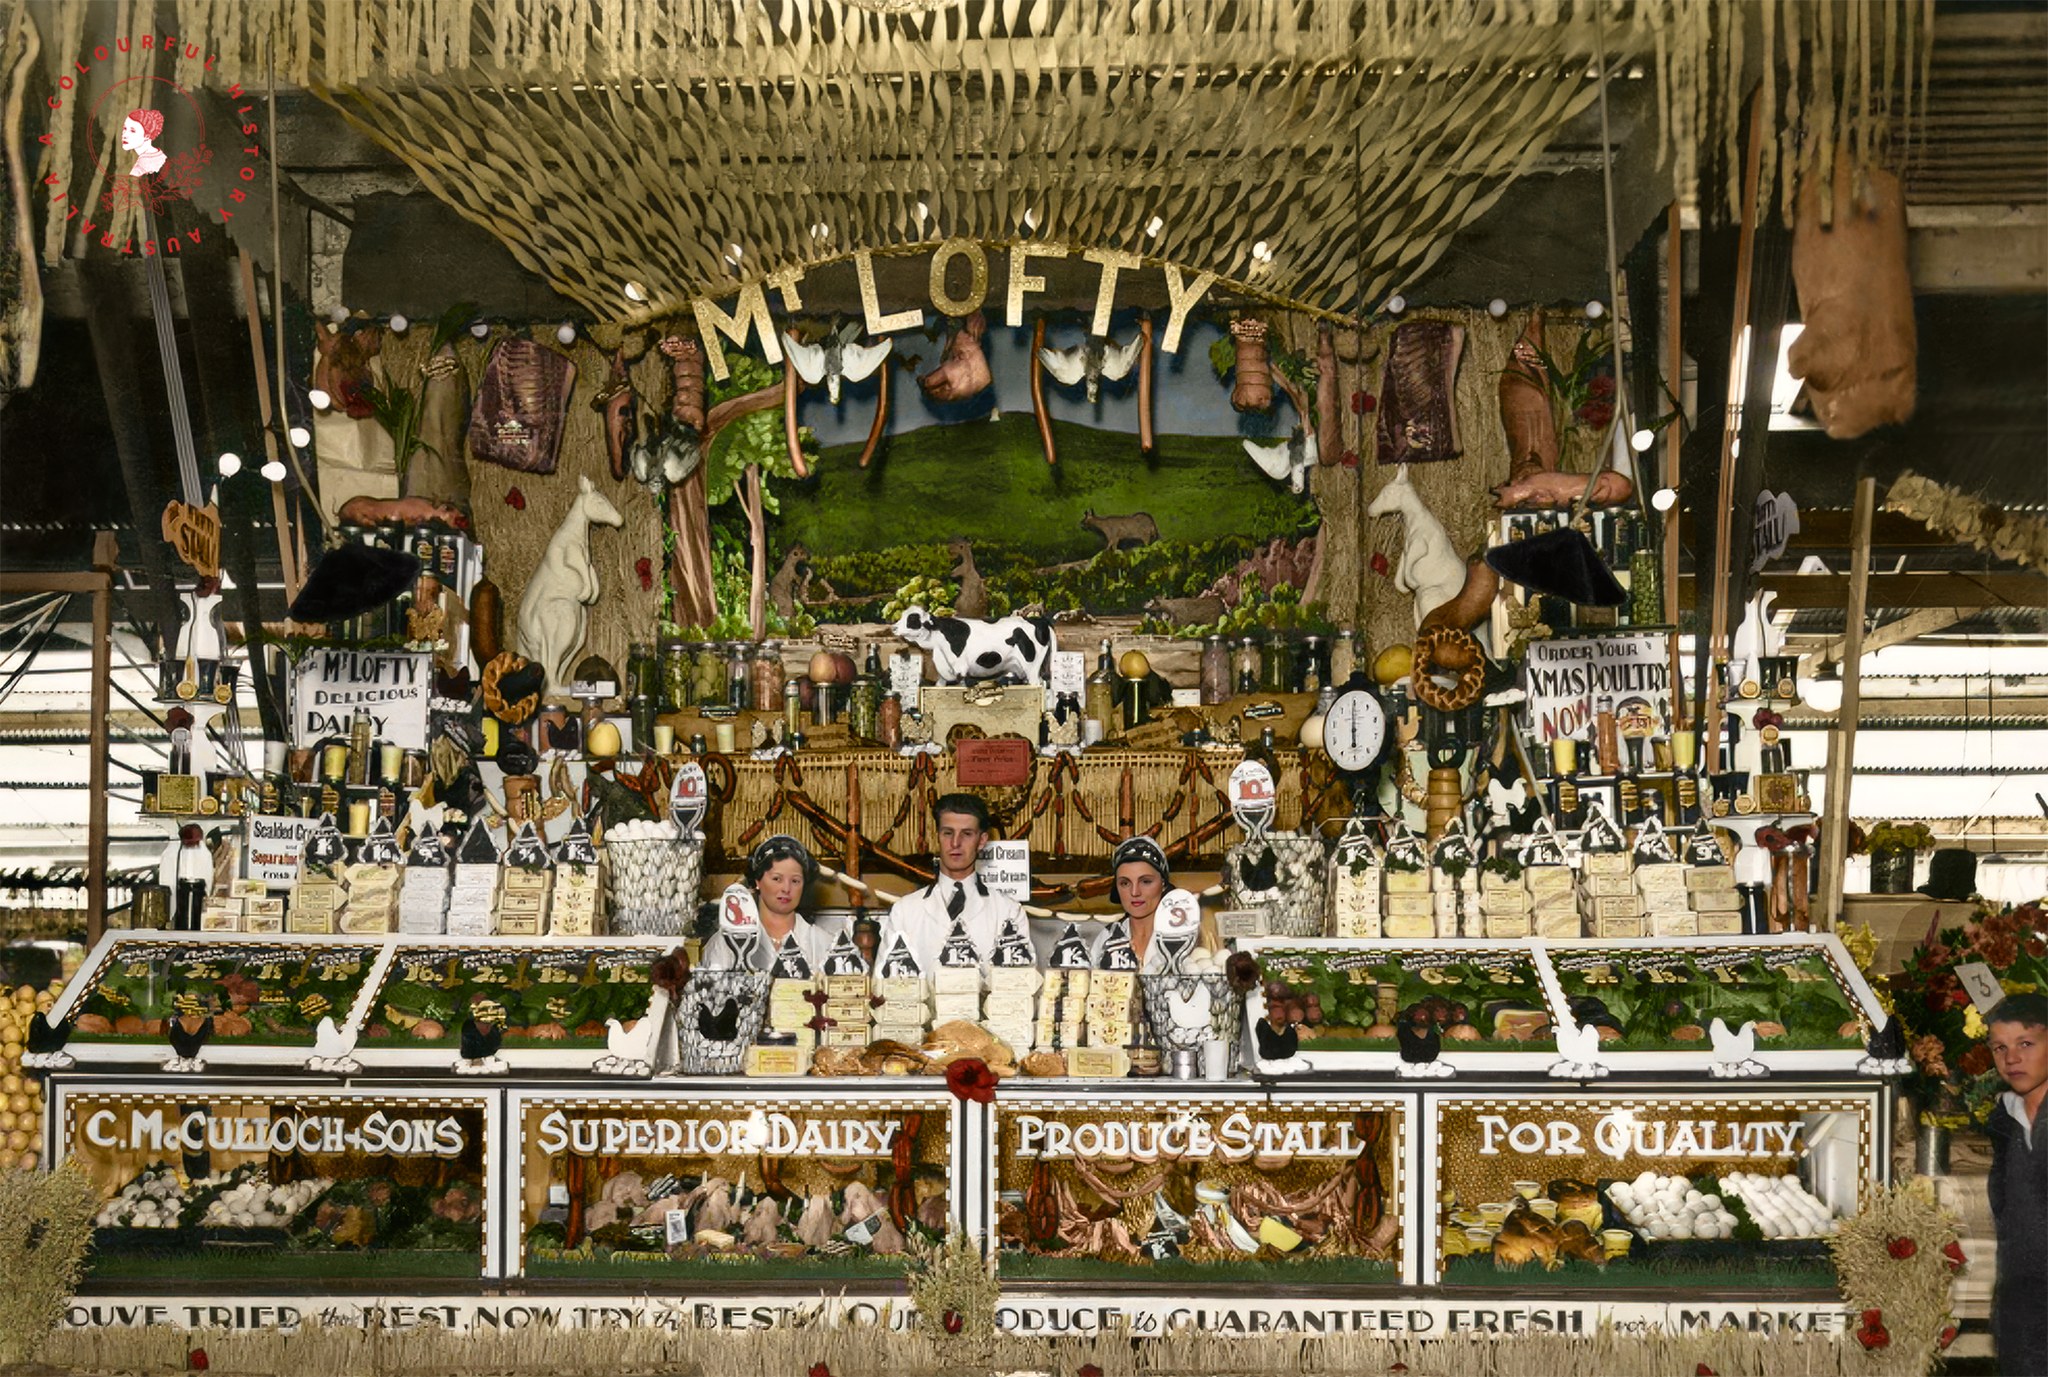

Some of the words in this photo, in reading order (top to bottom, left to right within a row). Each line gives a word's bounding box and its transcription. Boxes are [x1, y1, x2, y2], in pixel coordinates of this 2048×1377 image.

[854, 238, 1218, 354] LOFTY
[348, 652, 420, 685] LOFTY
[1537, 645, 1594, 663] ORDER
[1595, 640, 1639, 658] YOUR
[314, 687, 419, 706] DELICIOUS
[1529, 667, 1586, 698] XMAS
[1586, 661, 1671, 694] POULTRY
[306, 711, 390, 736] DAIY
[1541, 696, 1592, 743] NOW
[362, 1110, 465, 1157] SONS
[536, 1109, 762, 1155] SUPERIOR
[764, 1112, 900, 1155] DAIRY
[1014, 1114, 1216, 1158] PRODUCE
[1216, 1112, 1366, 1159] STALL
[1476, 1114, 1586, 1155] FOR
[1593, 1111, 1806, 1160] QUALITY
[182, 1305, 301, 1330] TRIED
[473, 1305, 562, 1329] NOW
[573, 1307, 645, 1330] TRY
[693, 1303, 793, 1331] BEST
[995, 1308, 1122, 1332] ODUCE
[1166, 1308, 1434, 1333] GUARANTEED
[1448, 1309, 1584, 1333] FRESH
